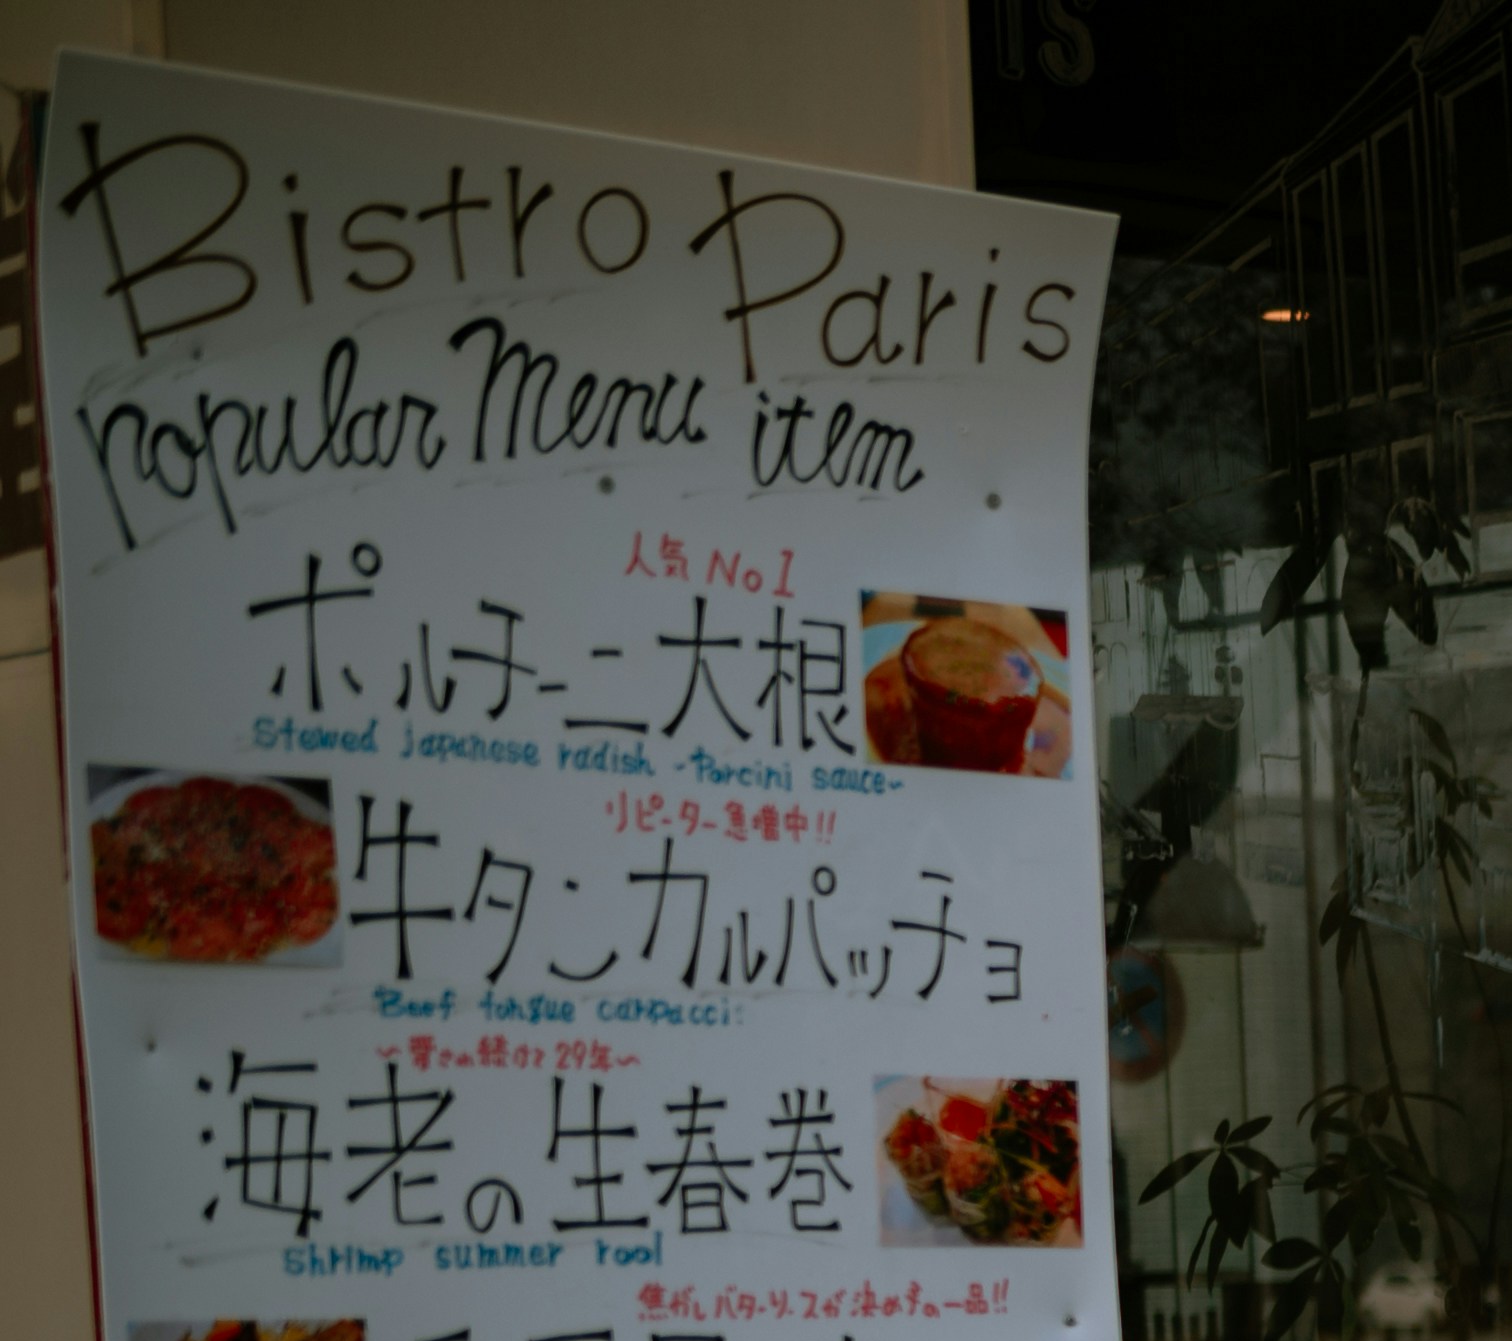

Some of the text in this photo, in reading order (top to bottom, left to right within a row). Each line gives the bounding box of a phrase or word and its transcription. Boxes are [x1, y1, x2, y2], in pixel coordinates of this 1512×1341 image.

[63, 123, 1076, 384] Bistro Paris
[77, 316, 925, 550] popular Menu item
[248, 542, 856, 757] ポルチーニ大根
[624, 531, 691, 580] 人気
[252, 716, 380, 756] Stewed
[557, 740, 656, 777] radish
[349, 796, 1025, 1003] 牛タンカルパッチョ
[197, 1050, 853, 1239] 海老の生春巻
[283, 1240, 404, 1278] Shrimp
[434, 1239, 565, 1269] summer
